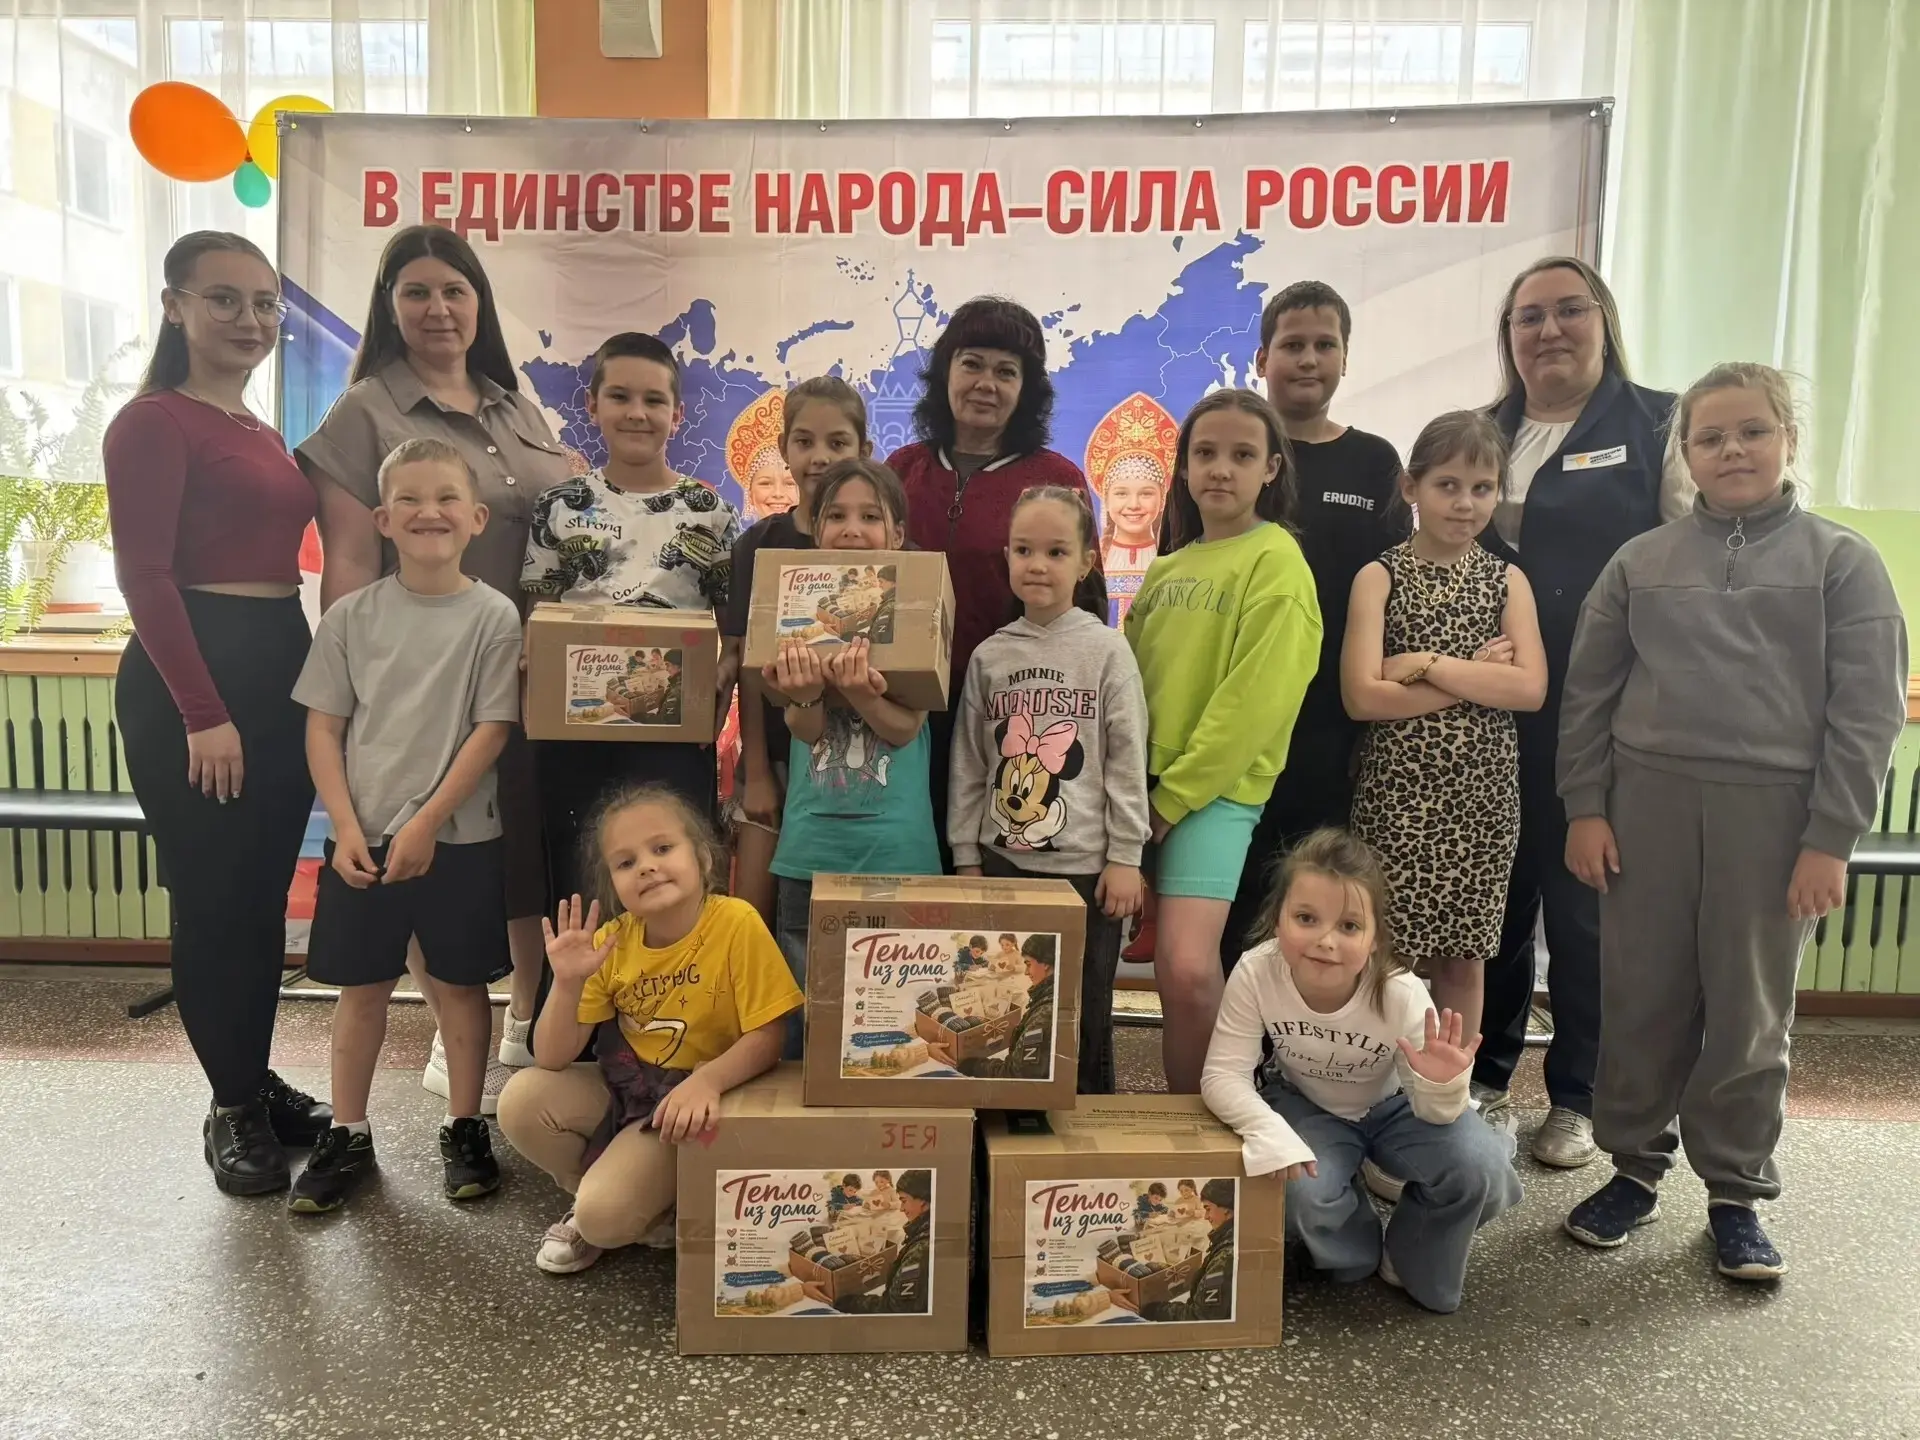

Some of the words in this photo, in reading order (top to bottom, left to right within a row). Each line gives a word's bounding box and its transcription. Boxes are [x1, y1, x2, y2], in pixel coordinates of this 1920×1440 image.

[363, 171, 399, 227] В
[421, 171, 731, 242] ЕДИНСТВЕ
[1245, 160, 1509, 229] РОССИИ
[1322, 491, 1375, 511] ERUDITE
[783, 567, 832, 591] Тепло
[794, 583, 805, 595] из
[570, 648, 619, 672] Тепло
[582, 664, 593, 676] из
[1008, 667, 1065, 686] MINNIE
[984, 688, 1097, 720] MOUSE
[852, 933, 940, 979] Тепло
[872, 966, 893, 985] из
[896, 963, 948, 988] дома
[1309, 1068, 1344, 1078] CLUB
[881, 1123, 938, 1150] ЗЕЯ
[722, 1173, 812, 1220] Тепло
[1032, 1184, 1119, 1231] Тепло
[744, 1206, 764, 1226] из
[768, 1202, 821, 1228] дома
[1052, 1217, 1073, 1235] из
[1076, 1213, 1128, 1238] дома
